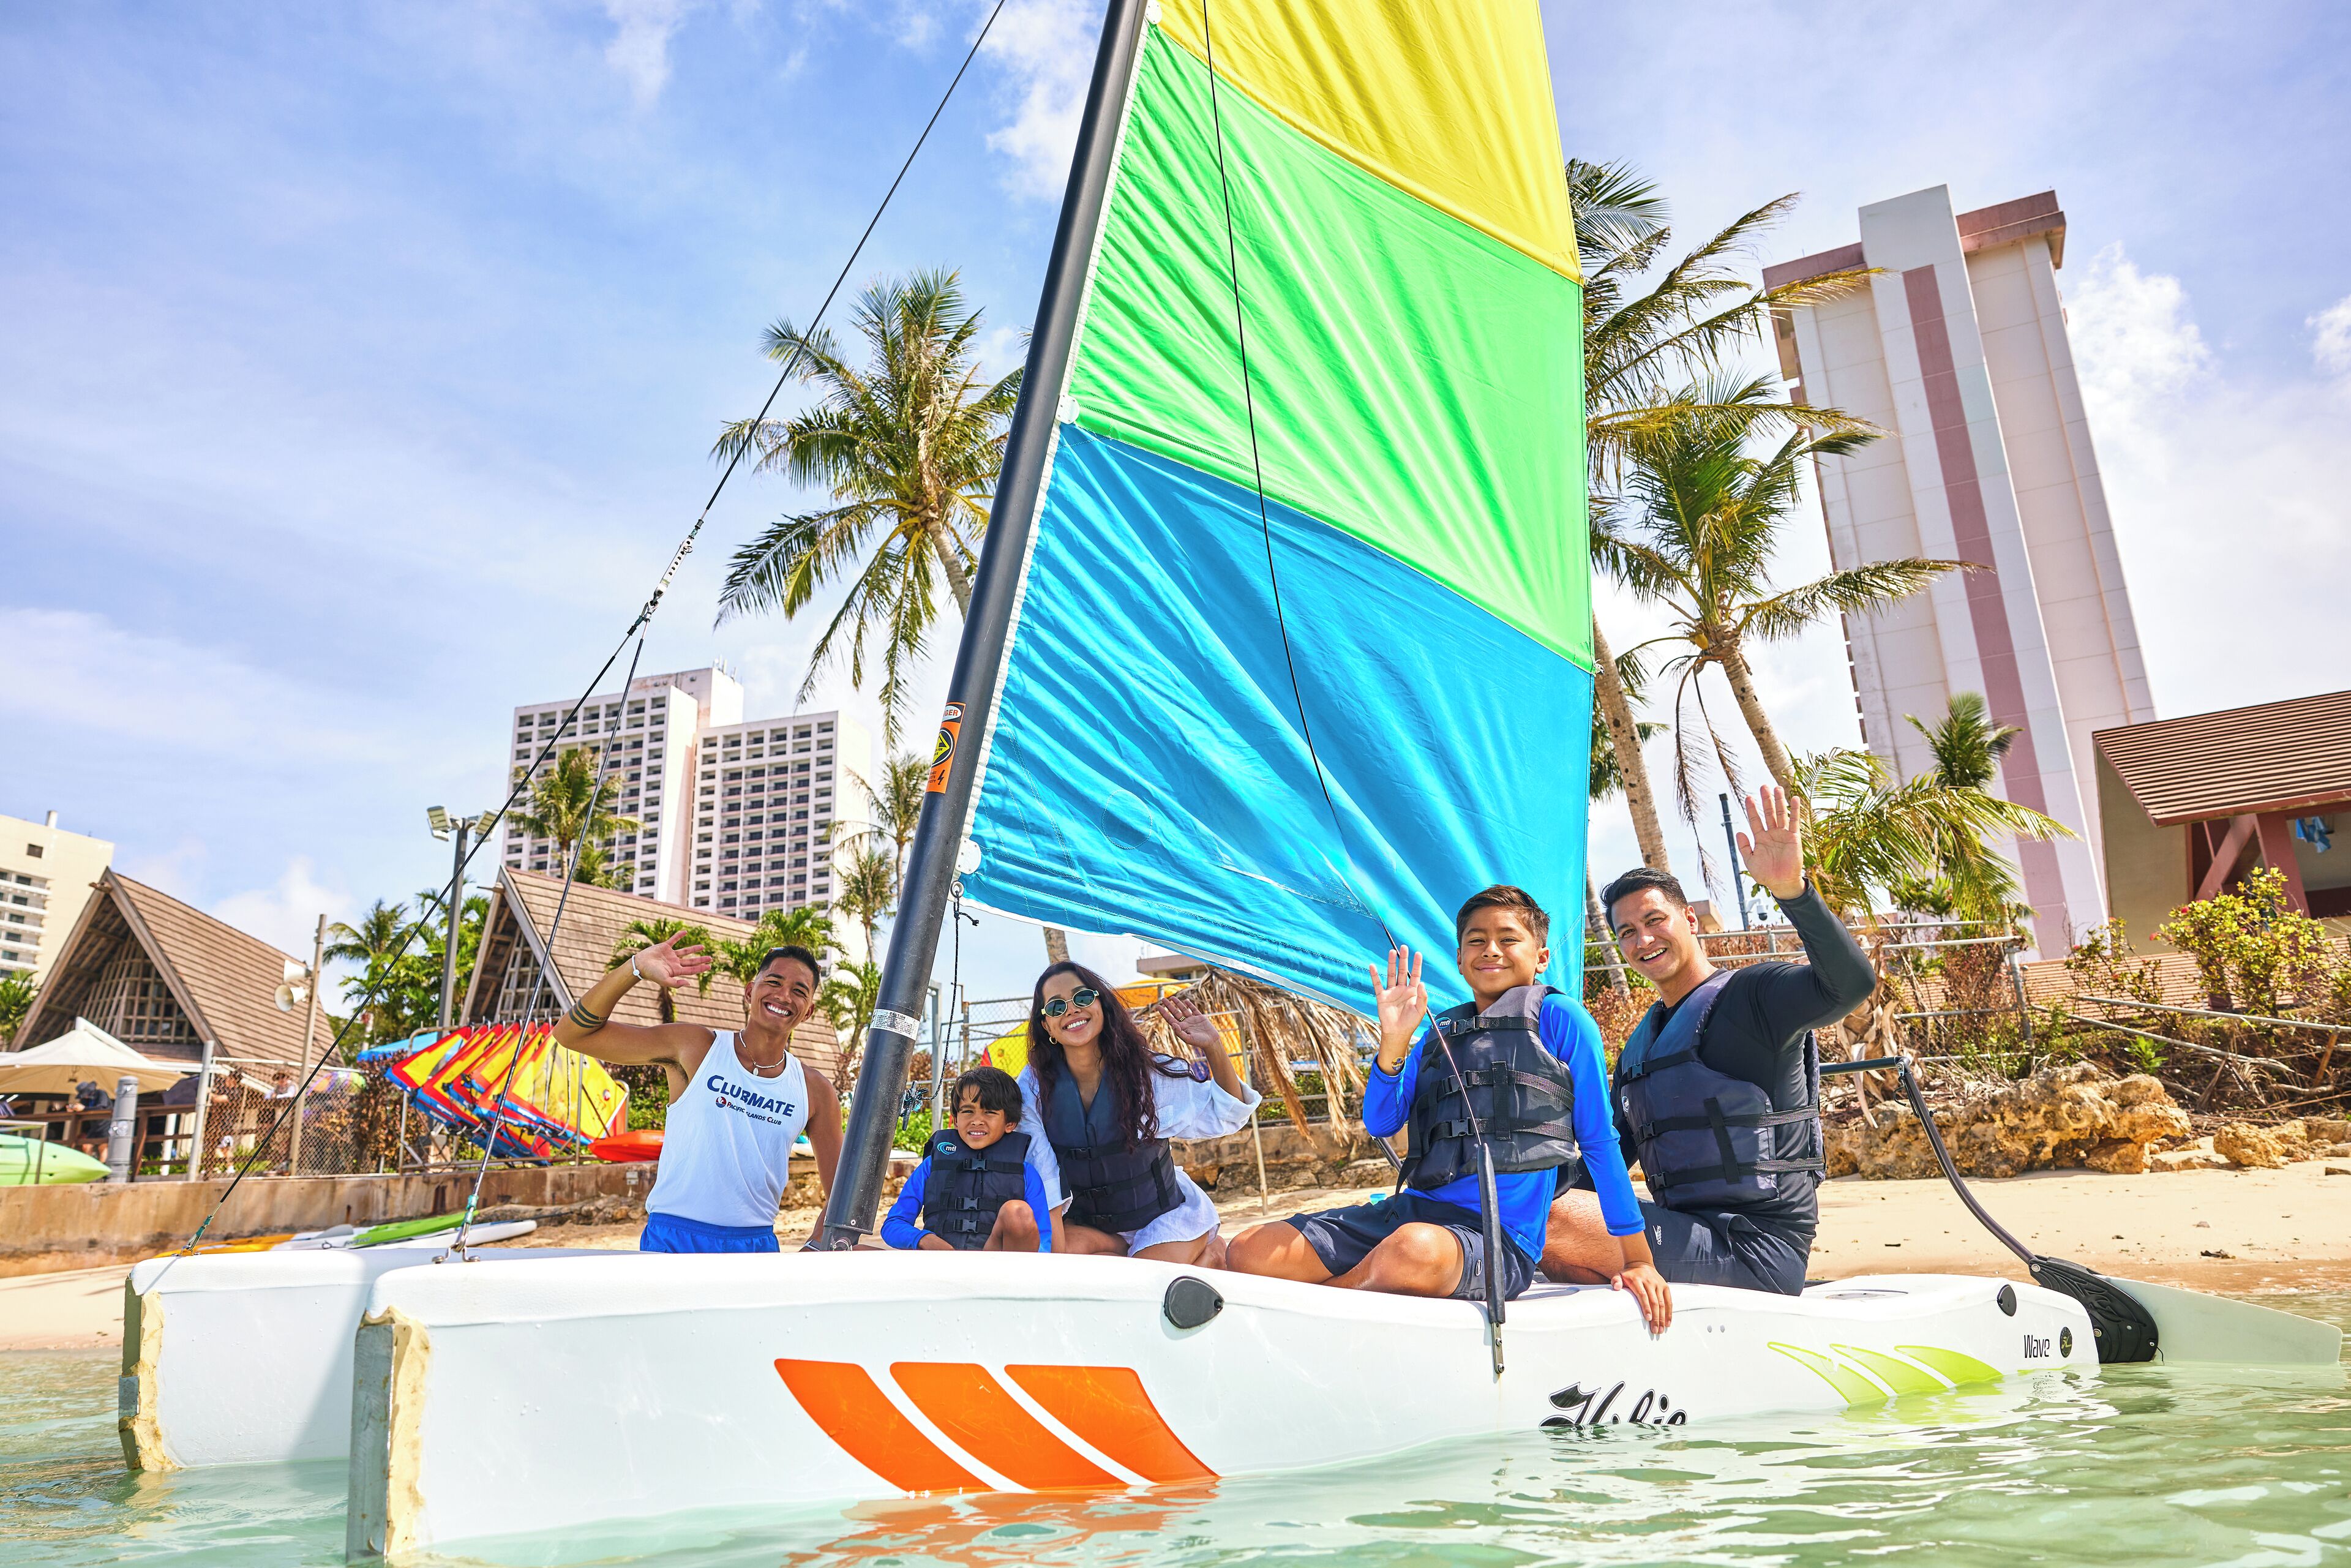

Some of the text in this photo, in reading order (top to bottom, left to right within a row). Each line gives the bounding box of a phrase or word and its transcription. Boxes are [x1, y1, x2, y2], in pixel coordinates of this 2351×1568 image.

[707, 1075, 795, 1117] CLUBMATE
[727, 1101, 782, 1125] PACIFIC SLANDS CLUB
[2023, 1334, 2050, 1359] Wave
